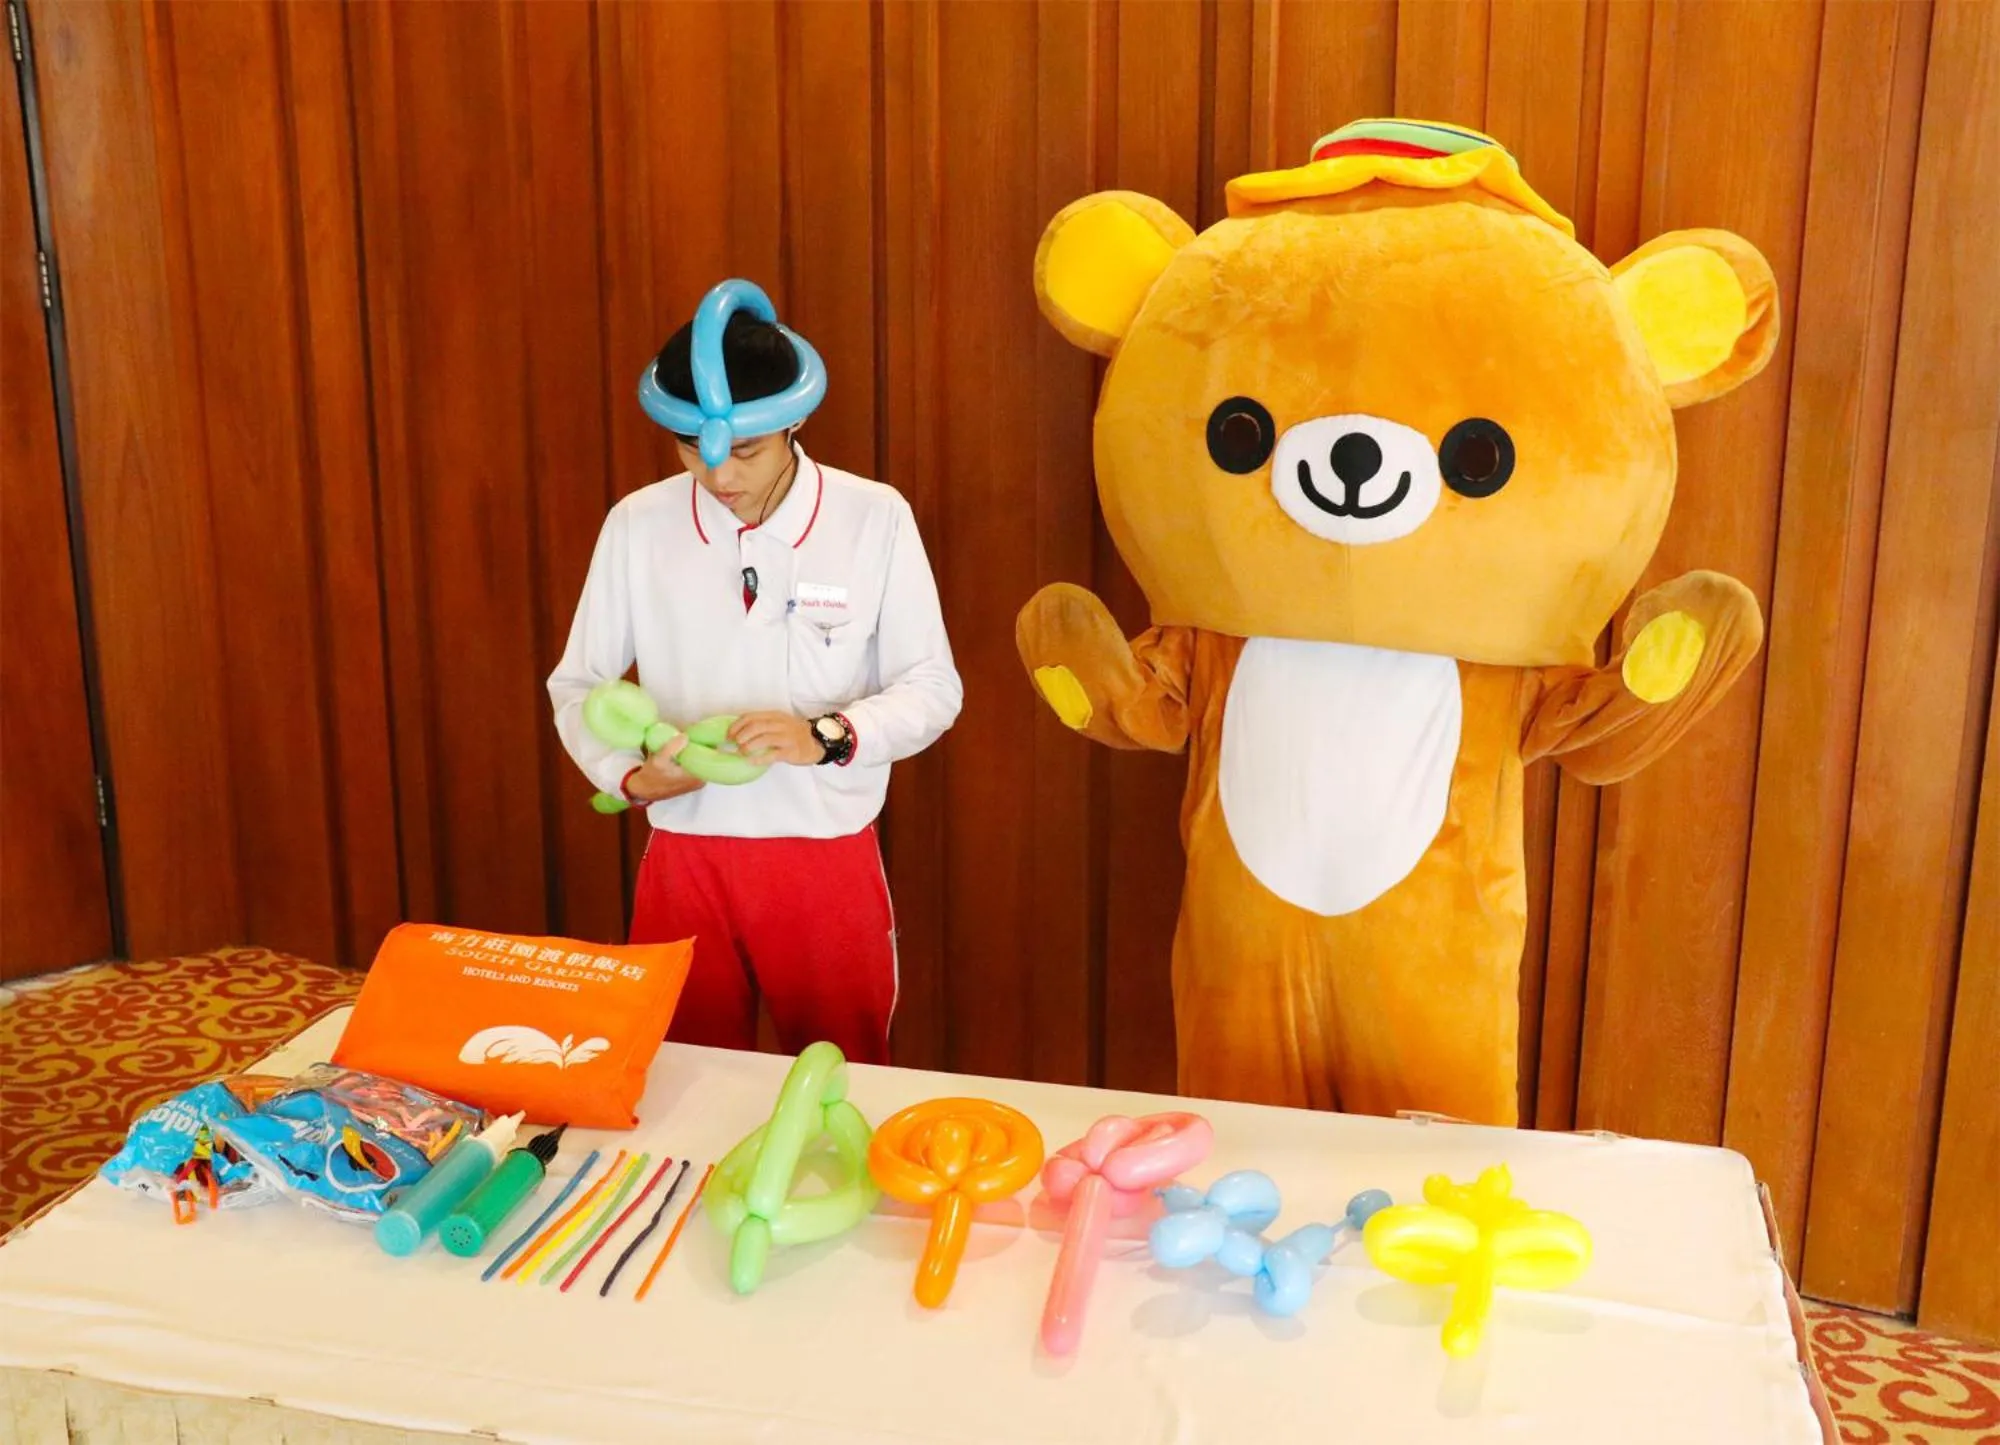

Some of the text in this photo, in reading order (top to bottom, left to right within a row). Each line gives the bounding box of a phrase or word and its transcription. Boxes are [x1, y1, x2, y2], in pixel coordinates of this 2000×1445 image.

[445, 946, 613, 984] SOUTH GARDEN
[462, 965, 580, 993] HOTELS AND RESORTS
